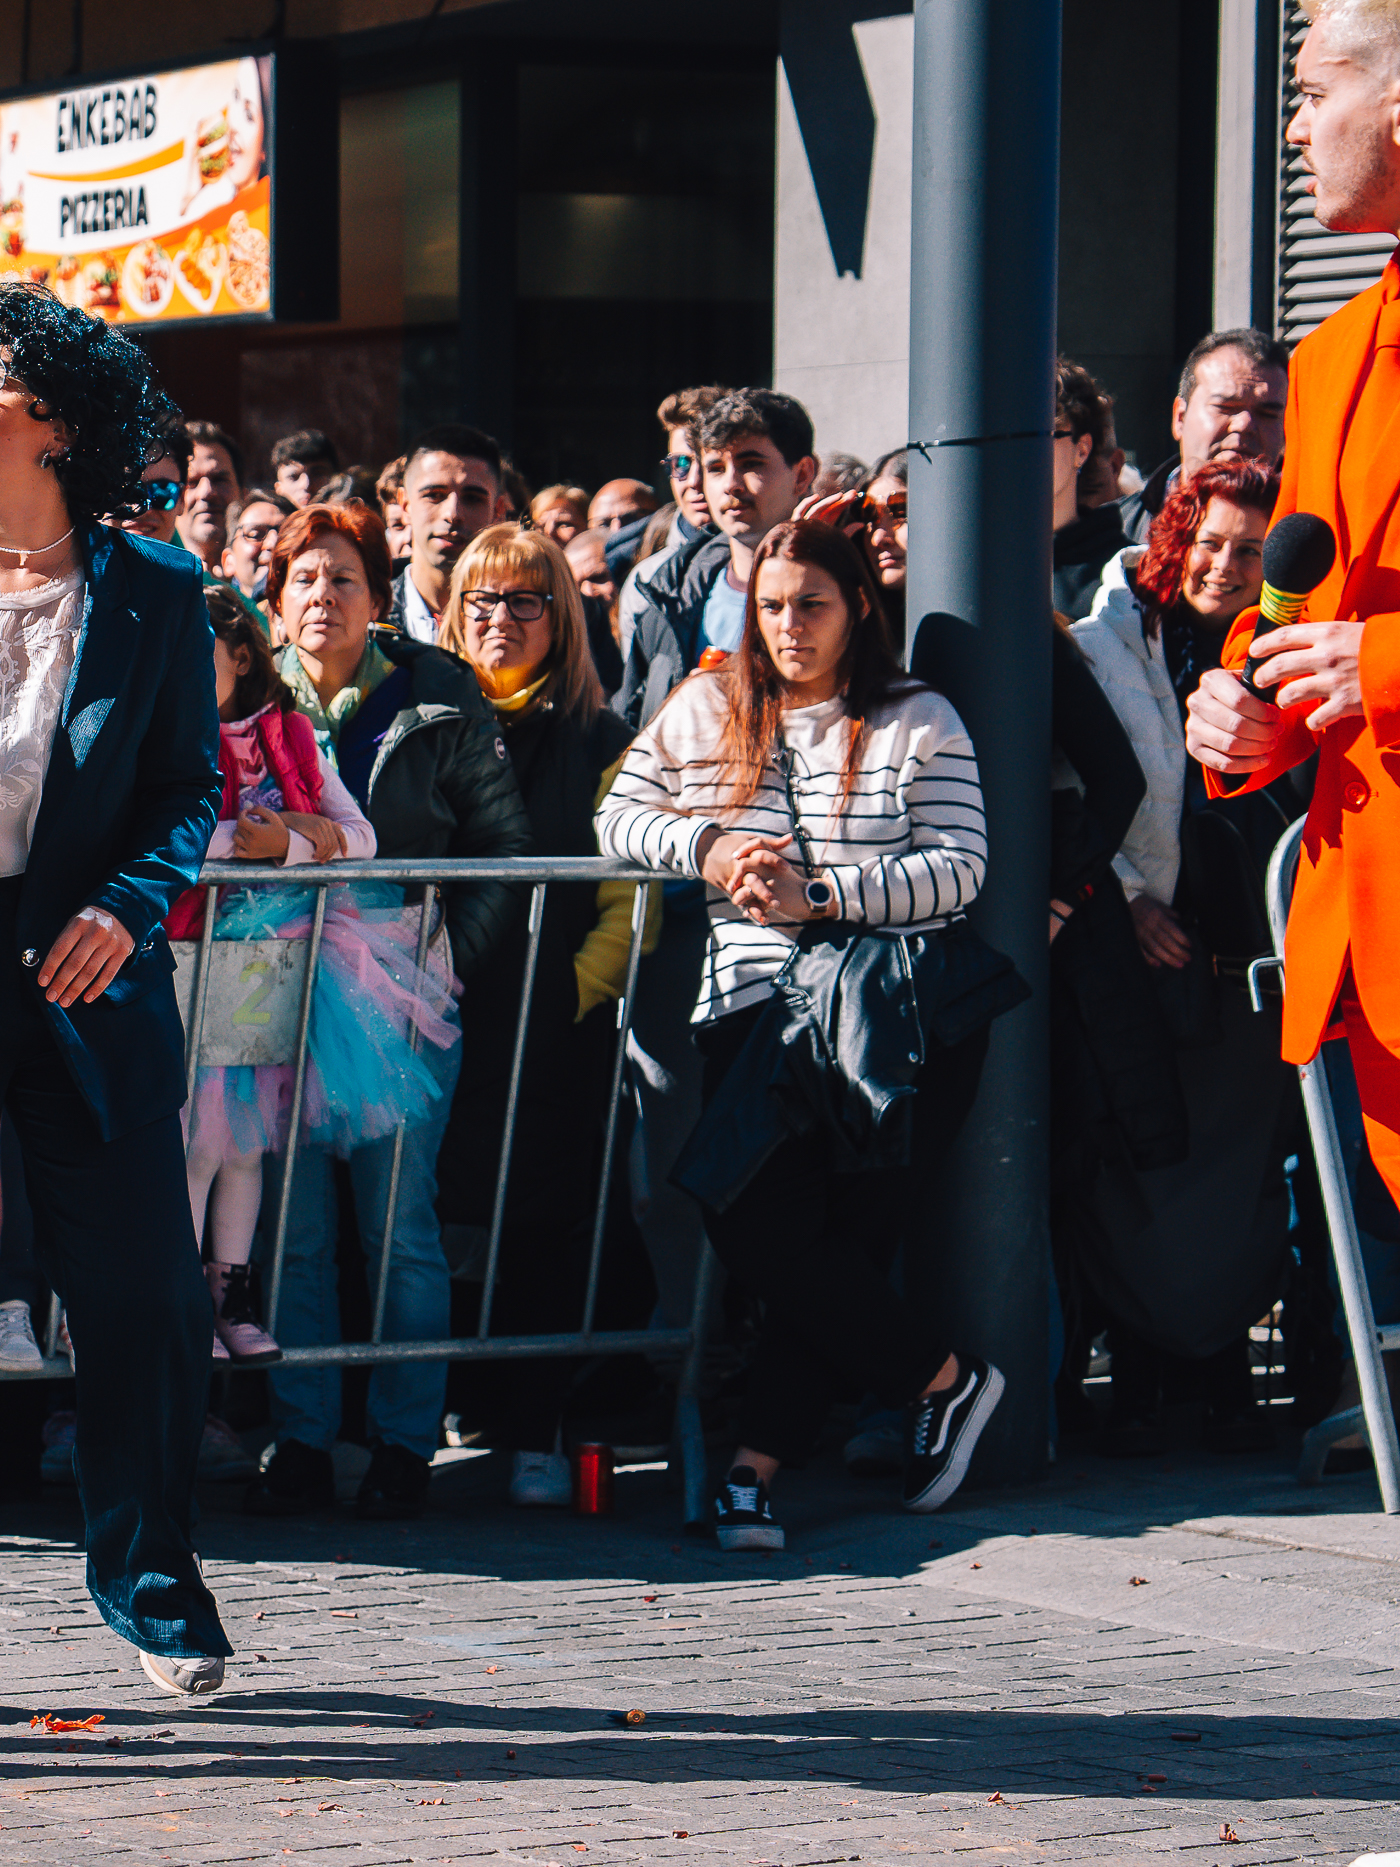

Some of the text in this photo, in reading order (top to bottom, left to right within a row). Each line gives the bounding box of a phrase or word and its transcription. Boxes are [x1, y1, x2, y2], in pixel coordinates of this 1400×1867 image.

[57, 83, 158, 153] ENKEBAB
[60, 185, 149, 238] PIZZERIA
[232, 961, 277, 1025] 2
